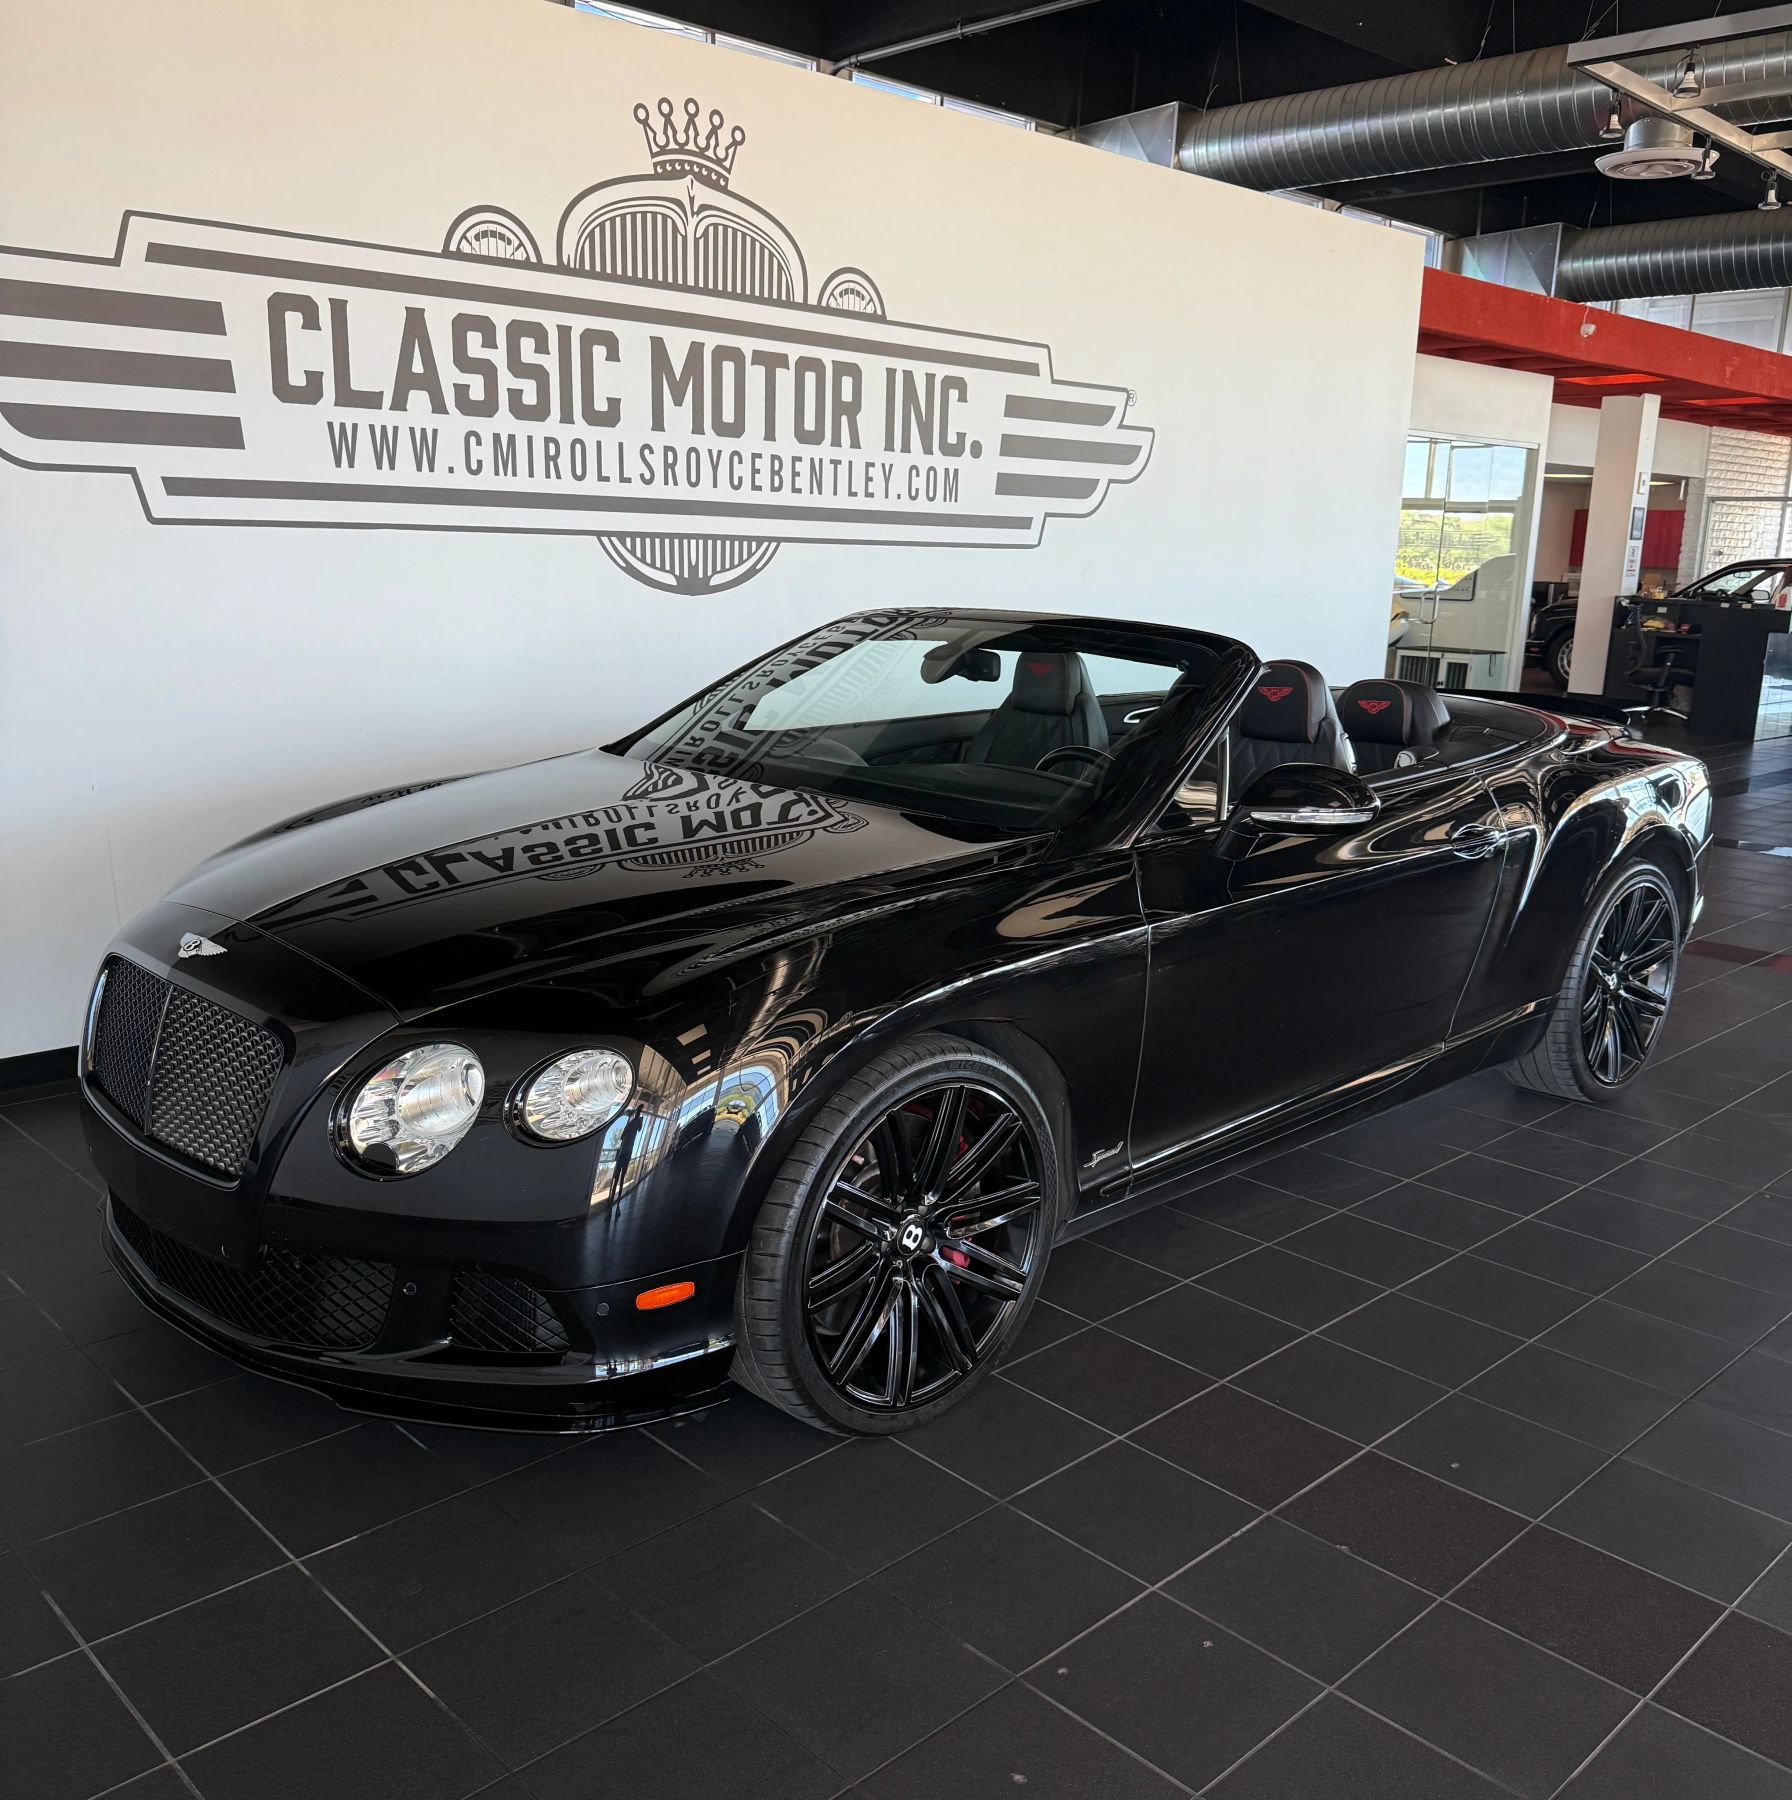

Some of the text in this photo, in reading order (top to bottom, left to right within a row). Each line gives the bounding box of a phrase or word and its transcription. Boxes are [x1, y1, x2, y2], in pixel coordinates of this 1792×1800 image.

[267, 291, 983, 460] CLASSIC MOTOR INC.
[327, 420, 959, 503] WWW.CMIROLLSROYCEBENTLEY.COM
